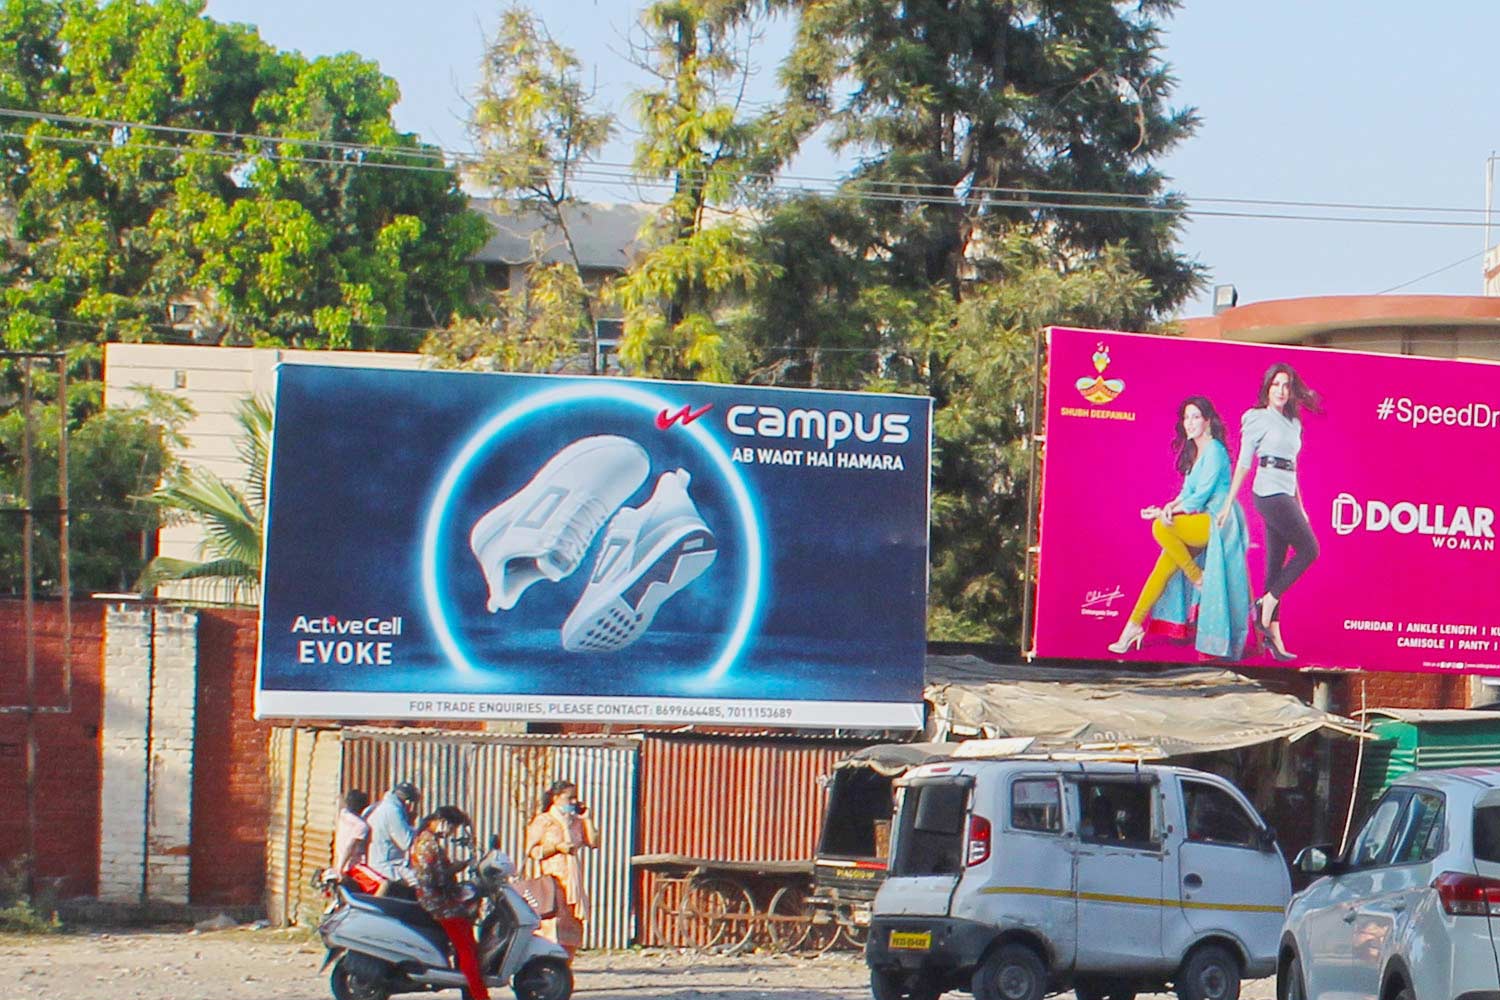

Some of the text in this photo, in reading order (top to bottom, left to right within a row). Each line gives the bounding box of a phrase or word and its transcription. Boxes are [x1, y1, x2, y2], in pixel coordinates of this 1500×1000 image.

[727, 404, 911, 449] campus
[731, 447, 905, 471] AB WAQT HAI HAMARA
[1366, 500, 1496, 538] DOLLAR
[1432, 536, 1496, 551] WOMAN
[1344, 620, 1394, 632] CHURIDAR
[1406, 622, 1438, 634] ANKLE
[1440, 623, 1477, 636] LENGTH
[298, 640, 394, 665] EVOKE
[1397, 637, 1445, 649] CAMISOLE
[1458, 640, 1489, 651] PANTY
[409, 701, 433, 712] FOR
[437, 701, 476, 713] TRADE
[479, 702, 546, 715] ENQUIRIES,
[550, 703, 593, 714] PLEASE
[597, 704, 653, 716] CONTACT:
[728, 707, 792, 719] 7011153689
